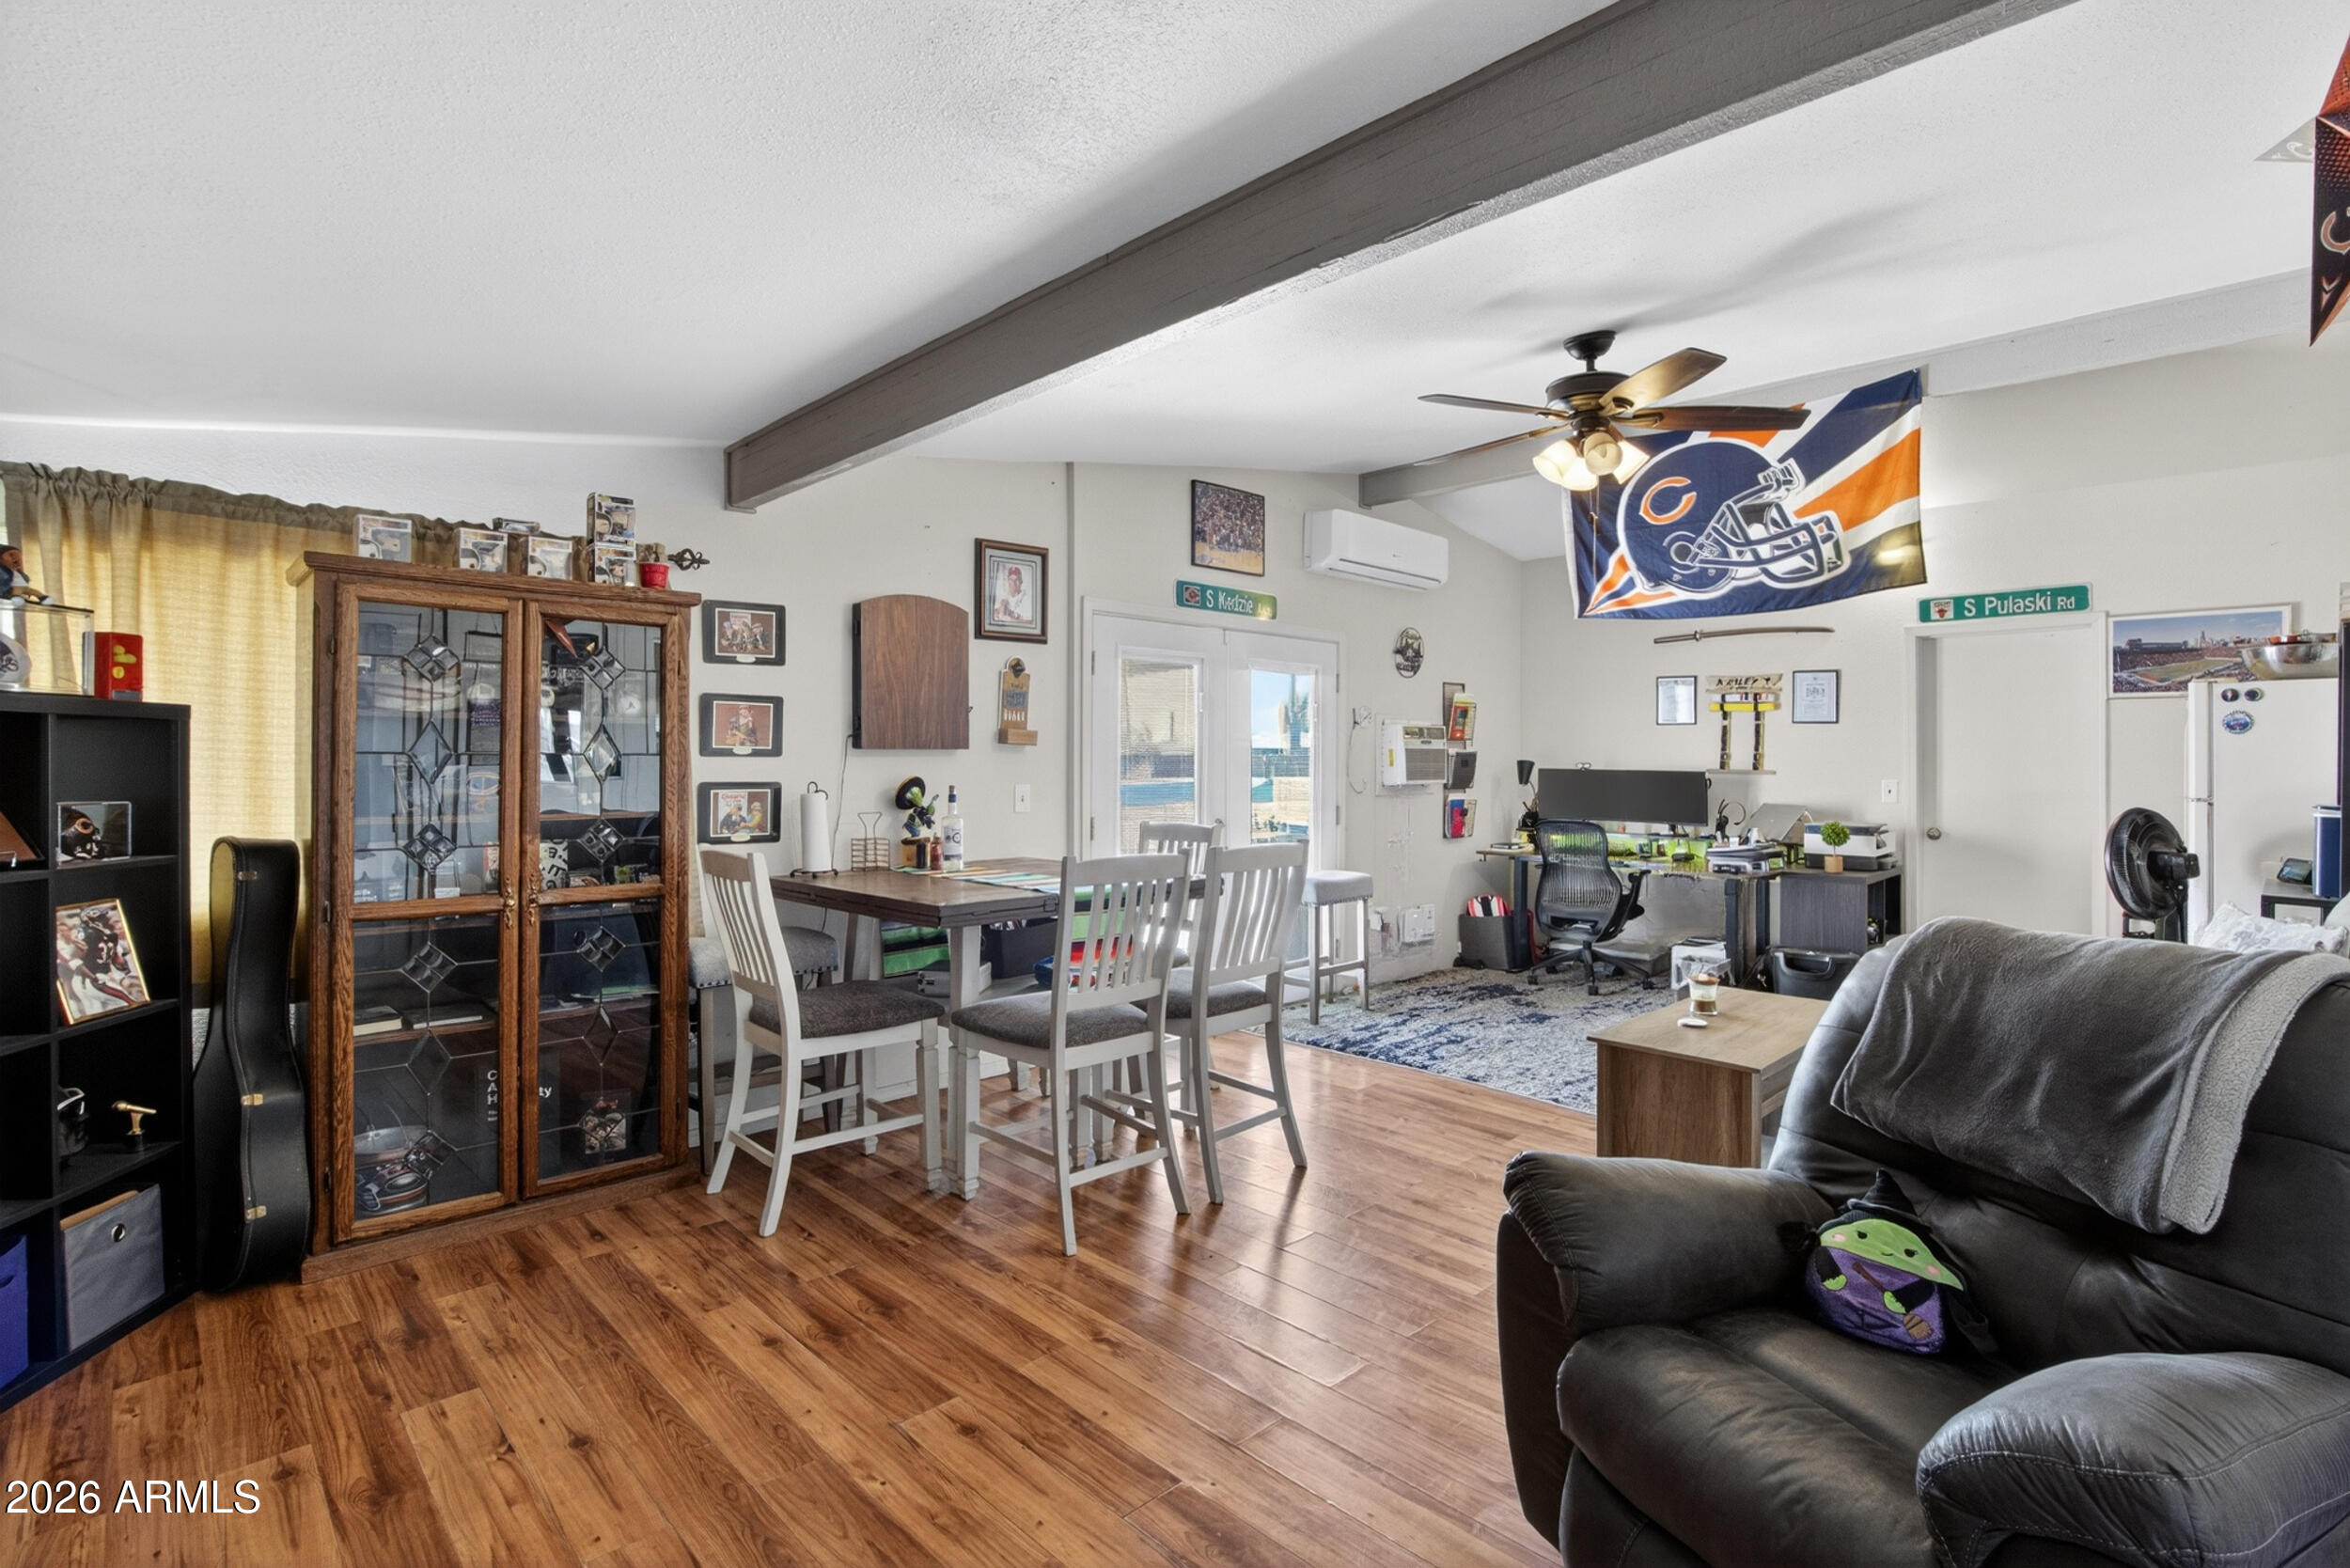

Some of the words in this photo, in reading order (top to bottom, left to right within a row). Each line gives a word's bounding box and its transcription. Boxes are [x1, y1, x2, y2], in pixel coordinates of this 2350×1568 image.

[1206, 589, 1214, 608] S
[1218, 590, 1254, 614] Kedzie
[1964, 598, 1977, 618] S
[1984, 591, 2051, 617] Pulaski
[2057, 596, 2076, 611] Rd
